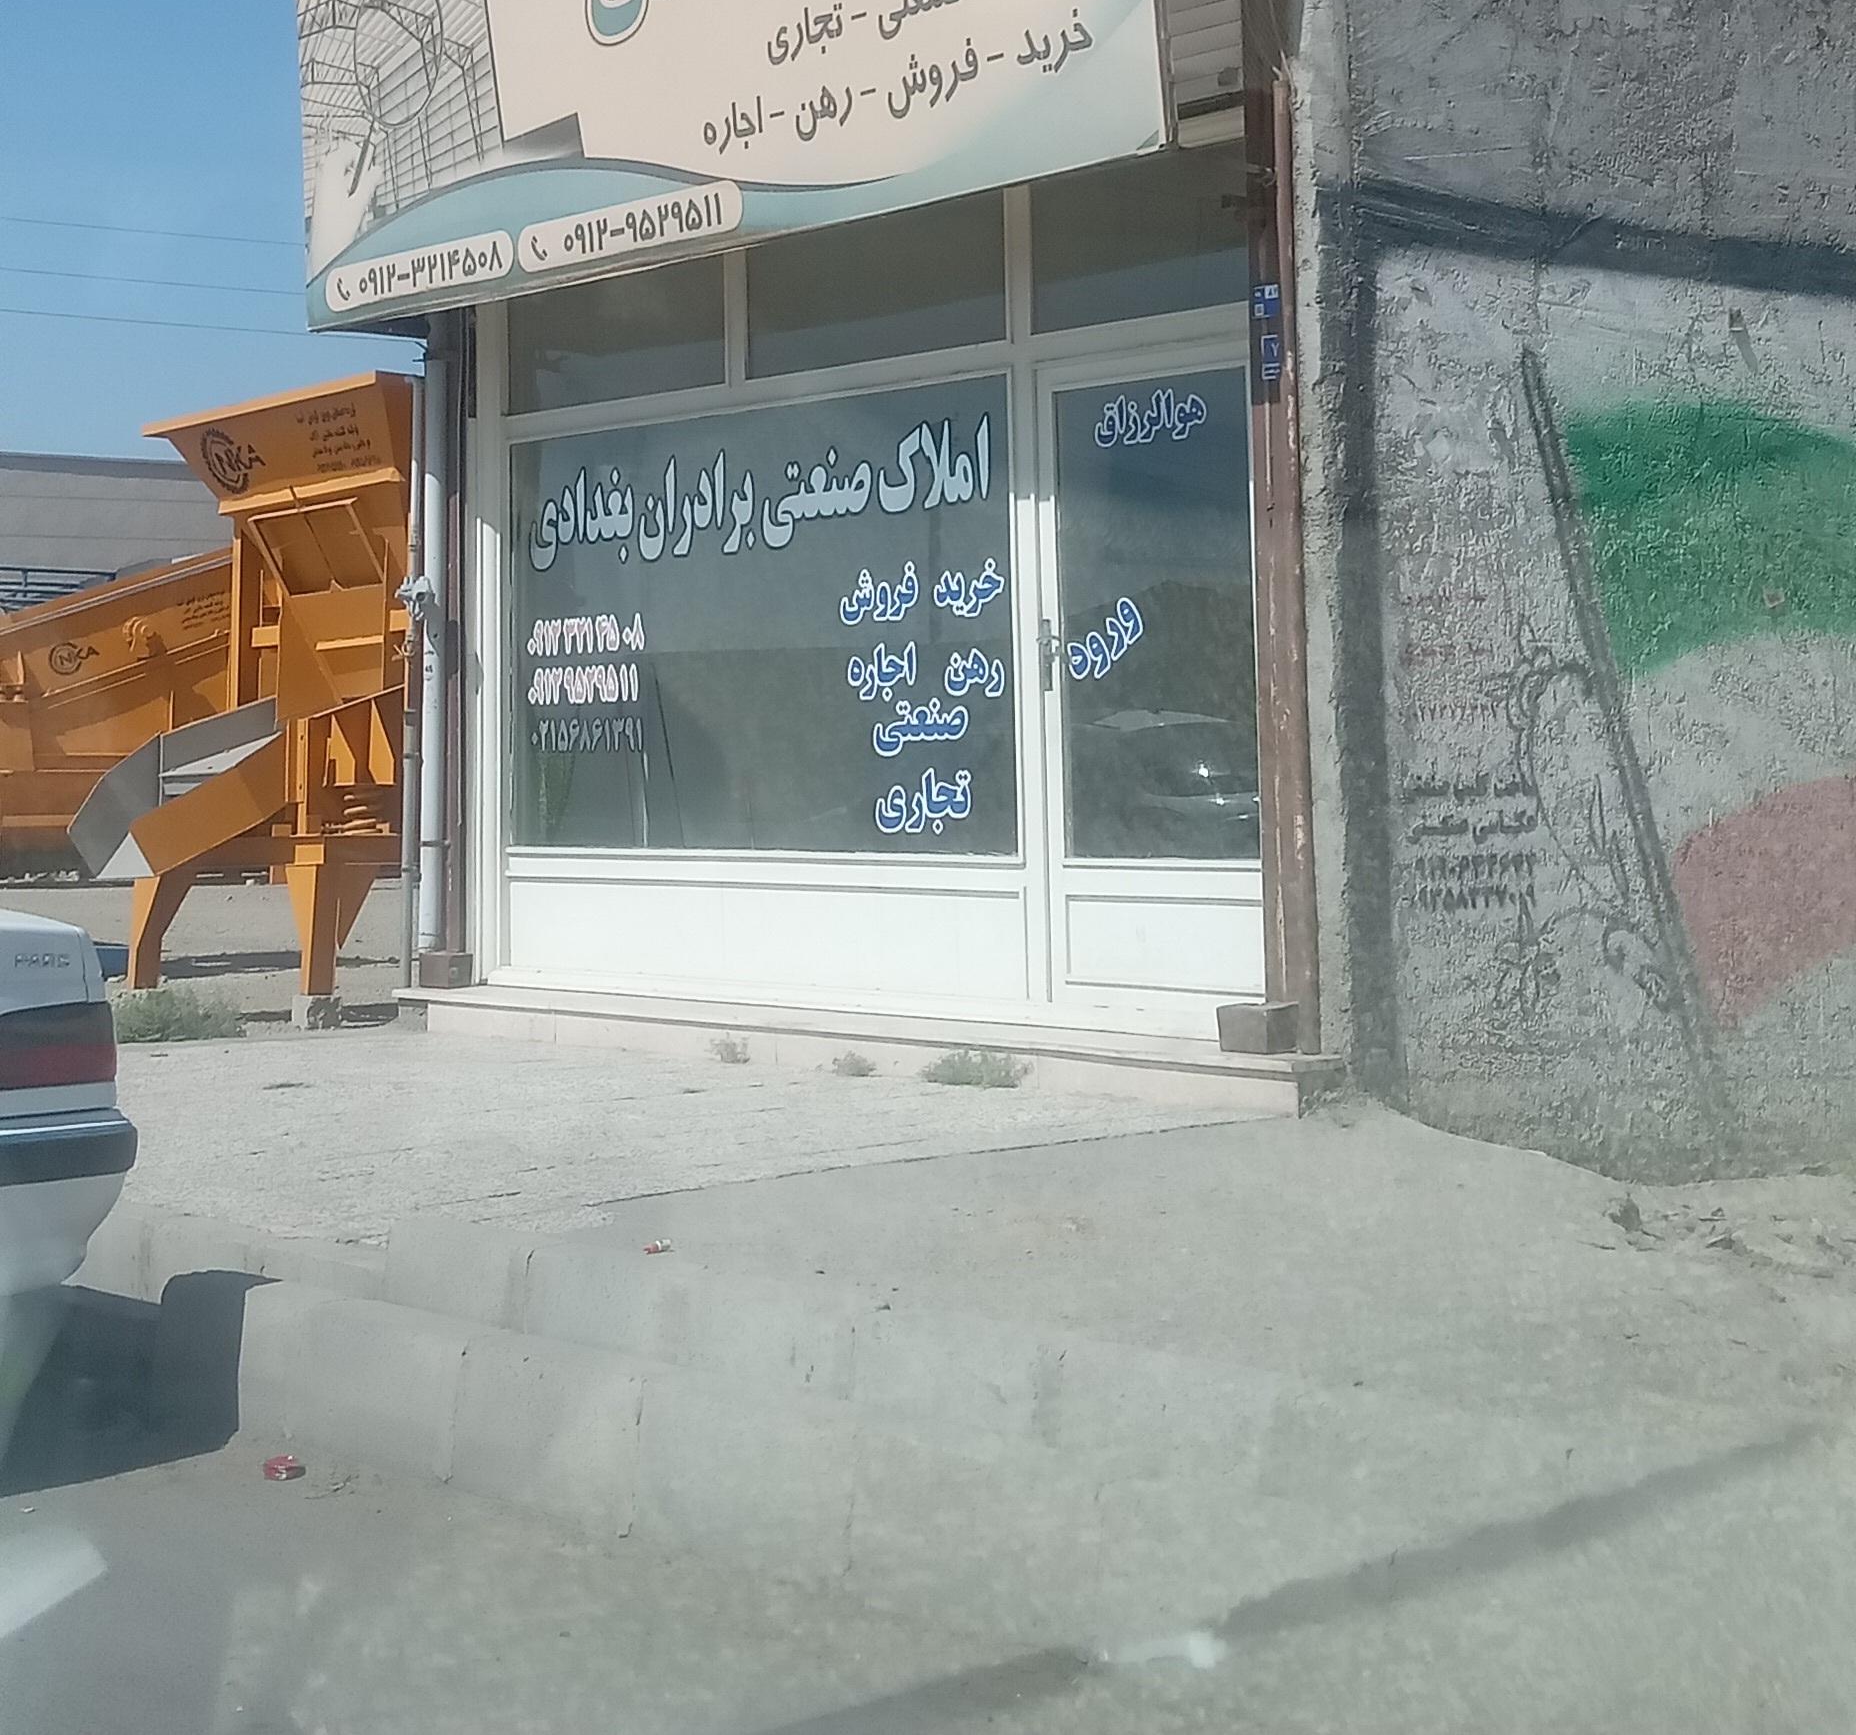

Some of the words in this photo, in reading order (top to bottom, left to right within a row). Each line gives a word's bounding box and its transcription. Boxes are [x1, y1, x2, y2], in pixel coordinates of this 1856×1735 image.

[767, 3, 844, 66] تجاری
[1016, 8, 1094, 73] خرید
[887, 37, 979, 119] فروش
[702, 95, 764, 155] اجاره
[795, 84, 853, 142] رهن
[879, 414, 991, 513] املاک
[529, 467, 635, 571] بغدادی
[638, 449, 755, 562] برادران
[762, 447, 872, 548] صنعتی
[840, 561, 919, 626] فروش
[934, 558, 1005, 617] خرید
[1067, 596, 1144, 679] ورود
[847, 640, 917, 701] اجاره
[944, 647, 1005, 697] رهن
[873, 697, 969, 757] صنعتی
[875, 767, 972, 835] تجاری
